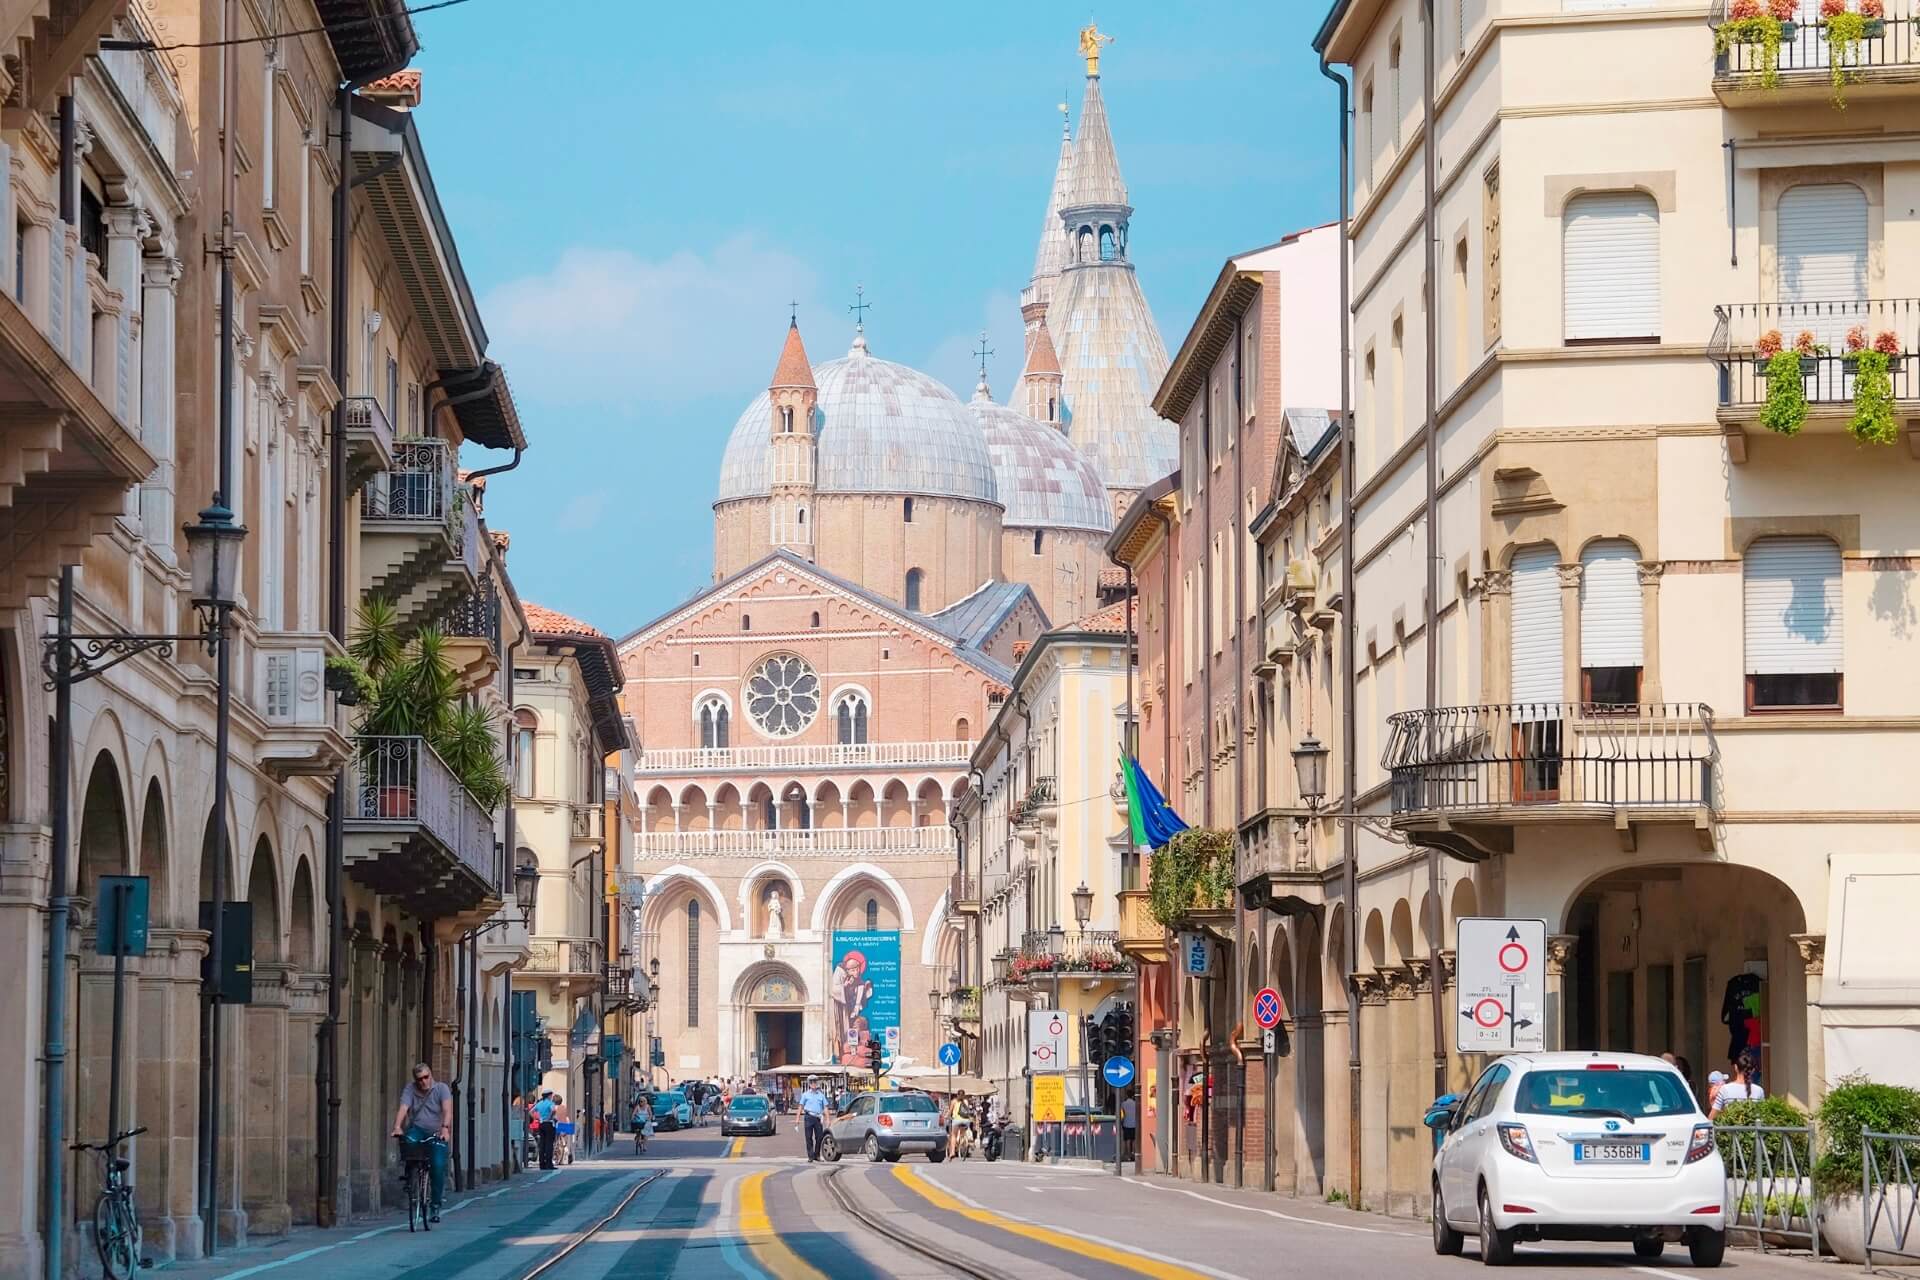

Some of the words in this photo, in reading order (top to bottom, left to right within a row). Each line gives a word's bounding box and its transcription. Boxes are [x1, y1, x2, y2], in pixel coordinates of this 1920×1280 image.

[1191, 936, 1205, 971] MIGNON
[1584, 1145, 1598, 1158] ET
[1604, 1145, 1641, 1158] 536BH
